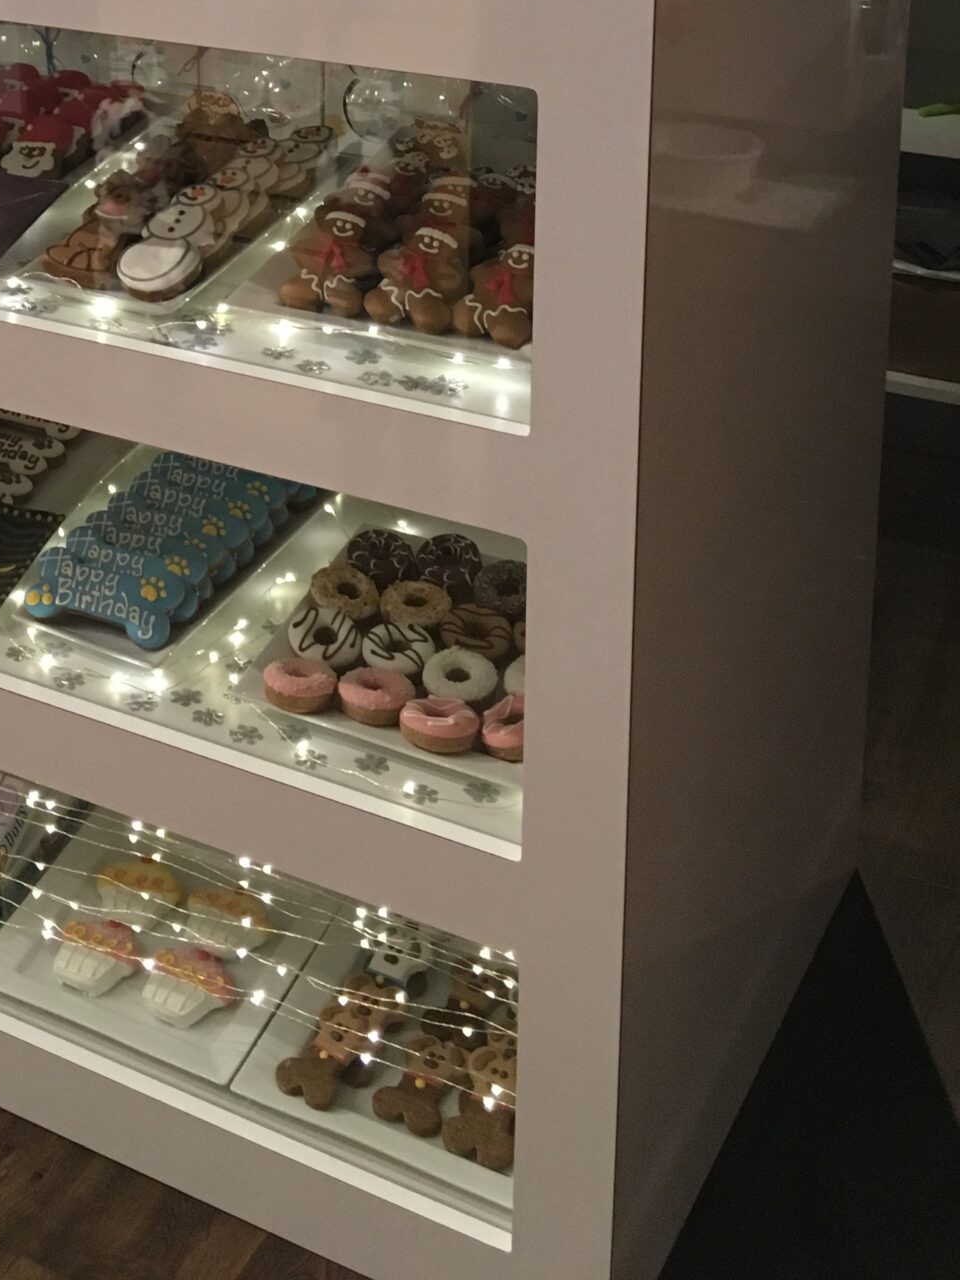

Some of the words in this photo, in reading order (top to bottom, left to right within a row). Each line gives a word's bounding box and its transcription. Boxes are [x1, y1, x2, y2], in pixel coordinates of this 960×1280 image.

[131, 473, 207, 518] Happy
[154, 454, 227, 500] Happy
[108, 496, 184, 537] Happy
[40, 551, 121, 596] Happy
[67, 528, 146, 577] Happy
[55, 575, 157, 640] Birthday
